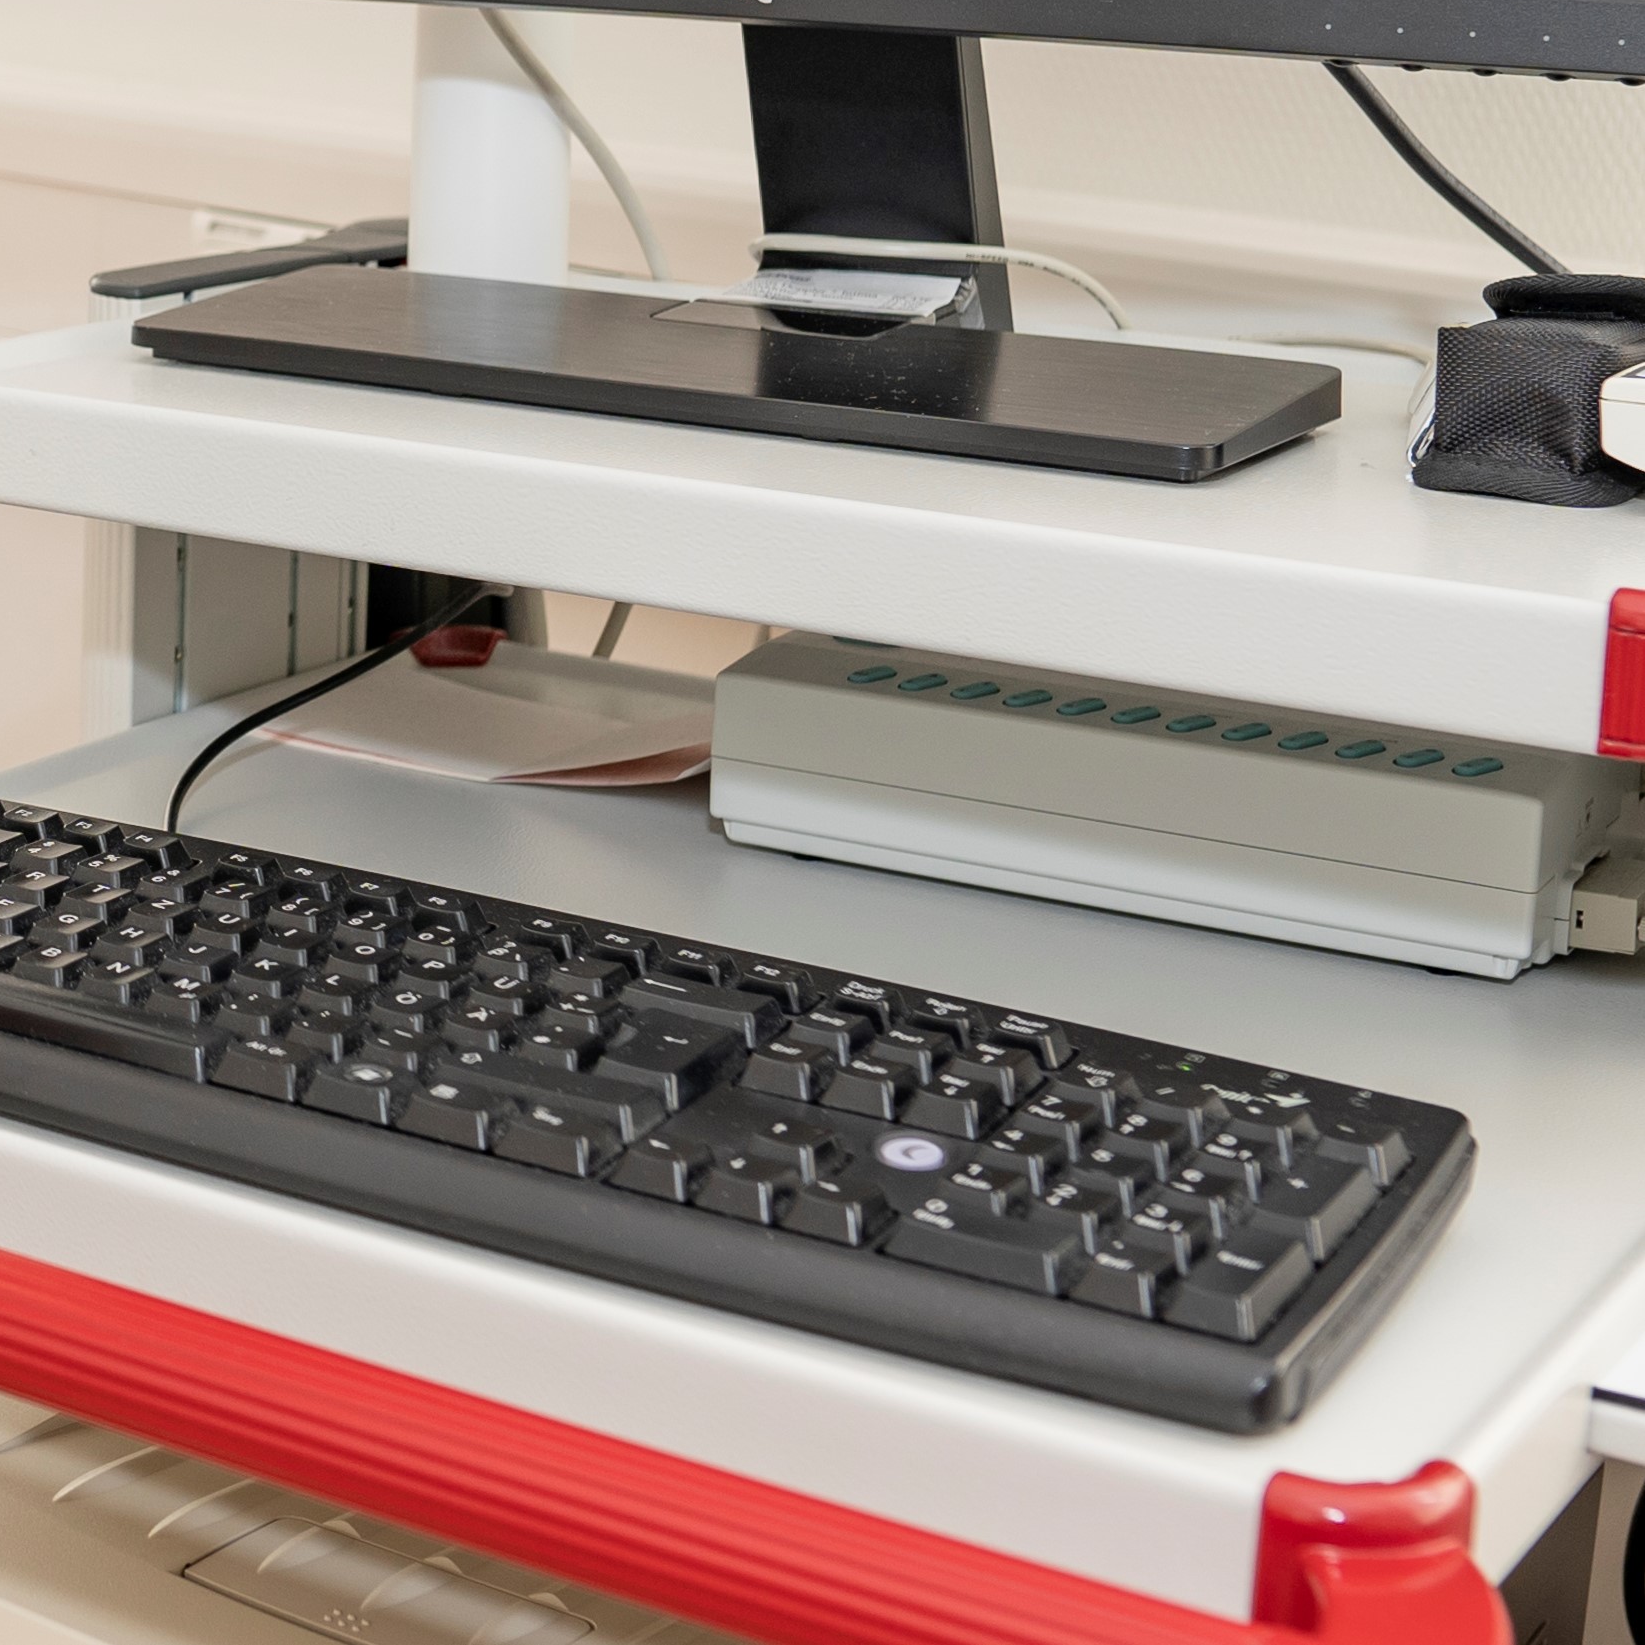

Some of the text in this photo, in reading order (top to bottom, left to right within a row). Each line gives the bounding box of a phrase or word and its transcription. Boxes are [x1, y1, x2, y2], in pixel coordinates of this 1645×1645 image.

[14, 809, 33, 818] F2
[75, 821, 93, 830] F3
[134, 833, 154, 844] F4
[229, 853, 248, 864] F5
[25, 871, 47, 882] R
[151, 874, 167, 884] 6
[90, 884, 111, 894] T
[151, 898, 176, 909] Z
[58, 913, 80, 925] G
[217, 913, 242, 925] U
[119, 927, 144, 940] H
[40, 947, 62, 959] B
[188, 944, 208, 955] J
[354, 944, 376, 956] O
[106, 962, 131, 975] N
[254, 959, 279, 972] K
[421, 960, 446, 970] P
[173, 977, 201, 992] M
[325, 975, 341, 987] L
[492, 975, 519, 990] Ü
[394, 991, 423, 1006] Ö
